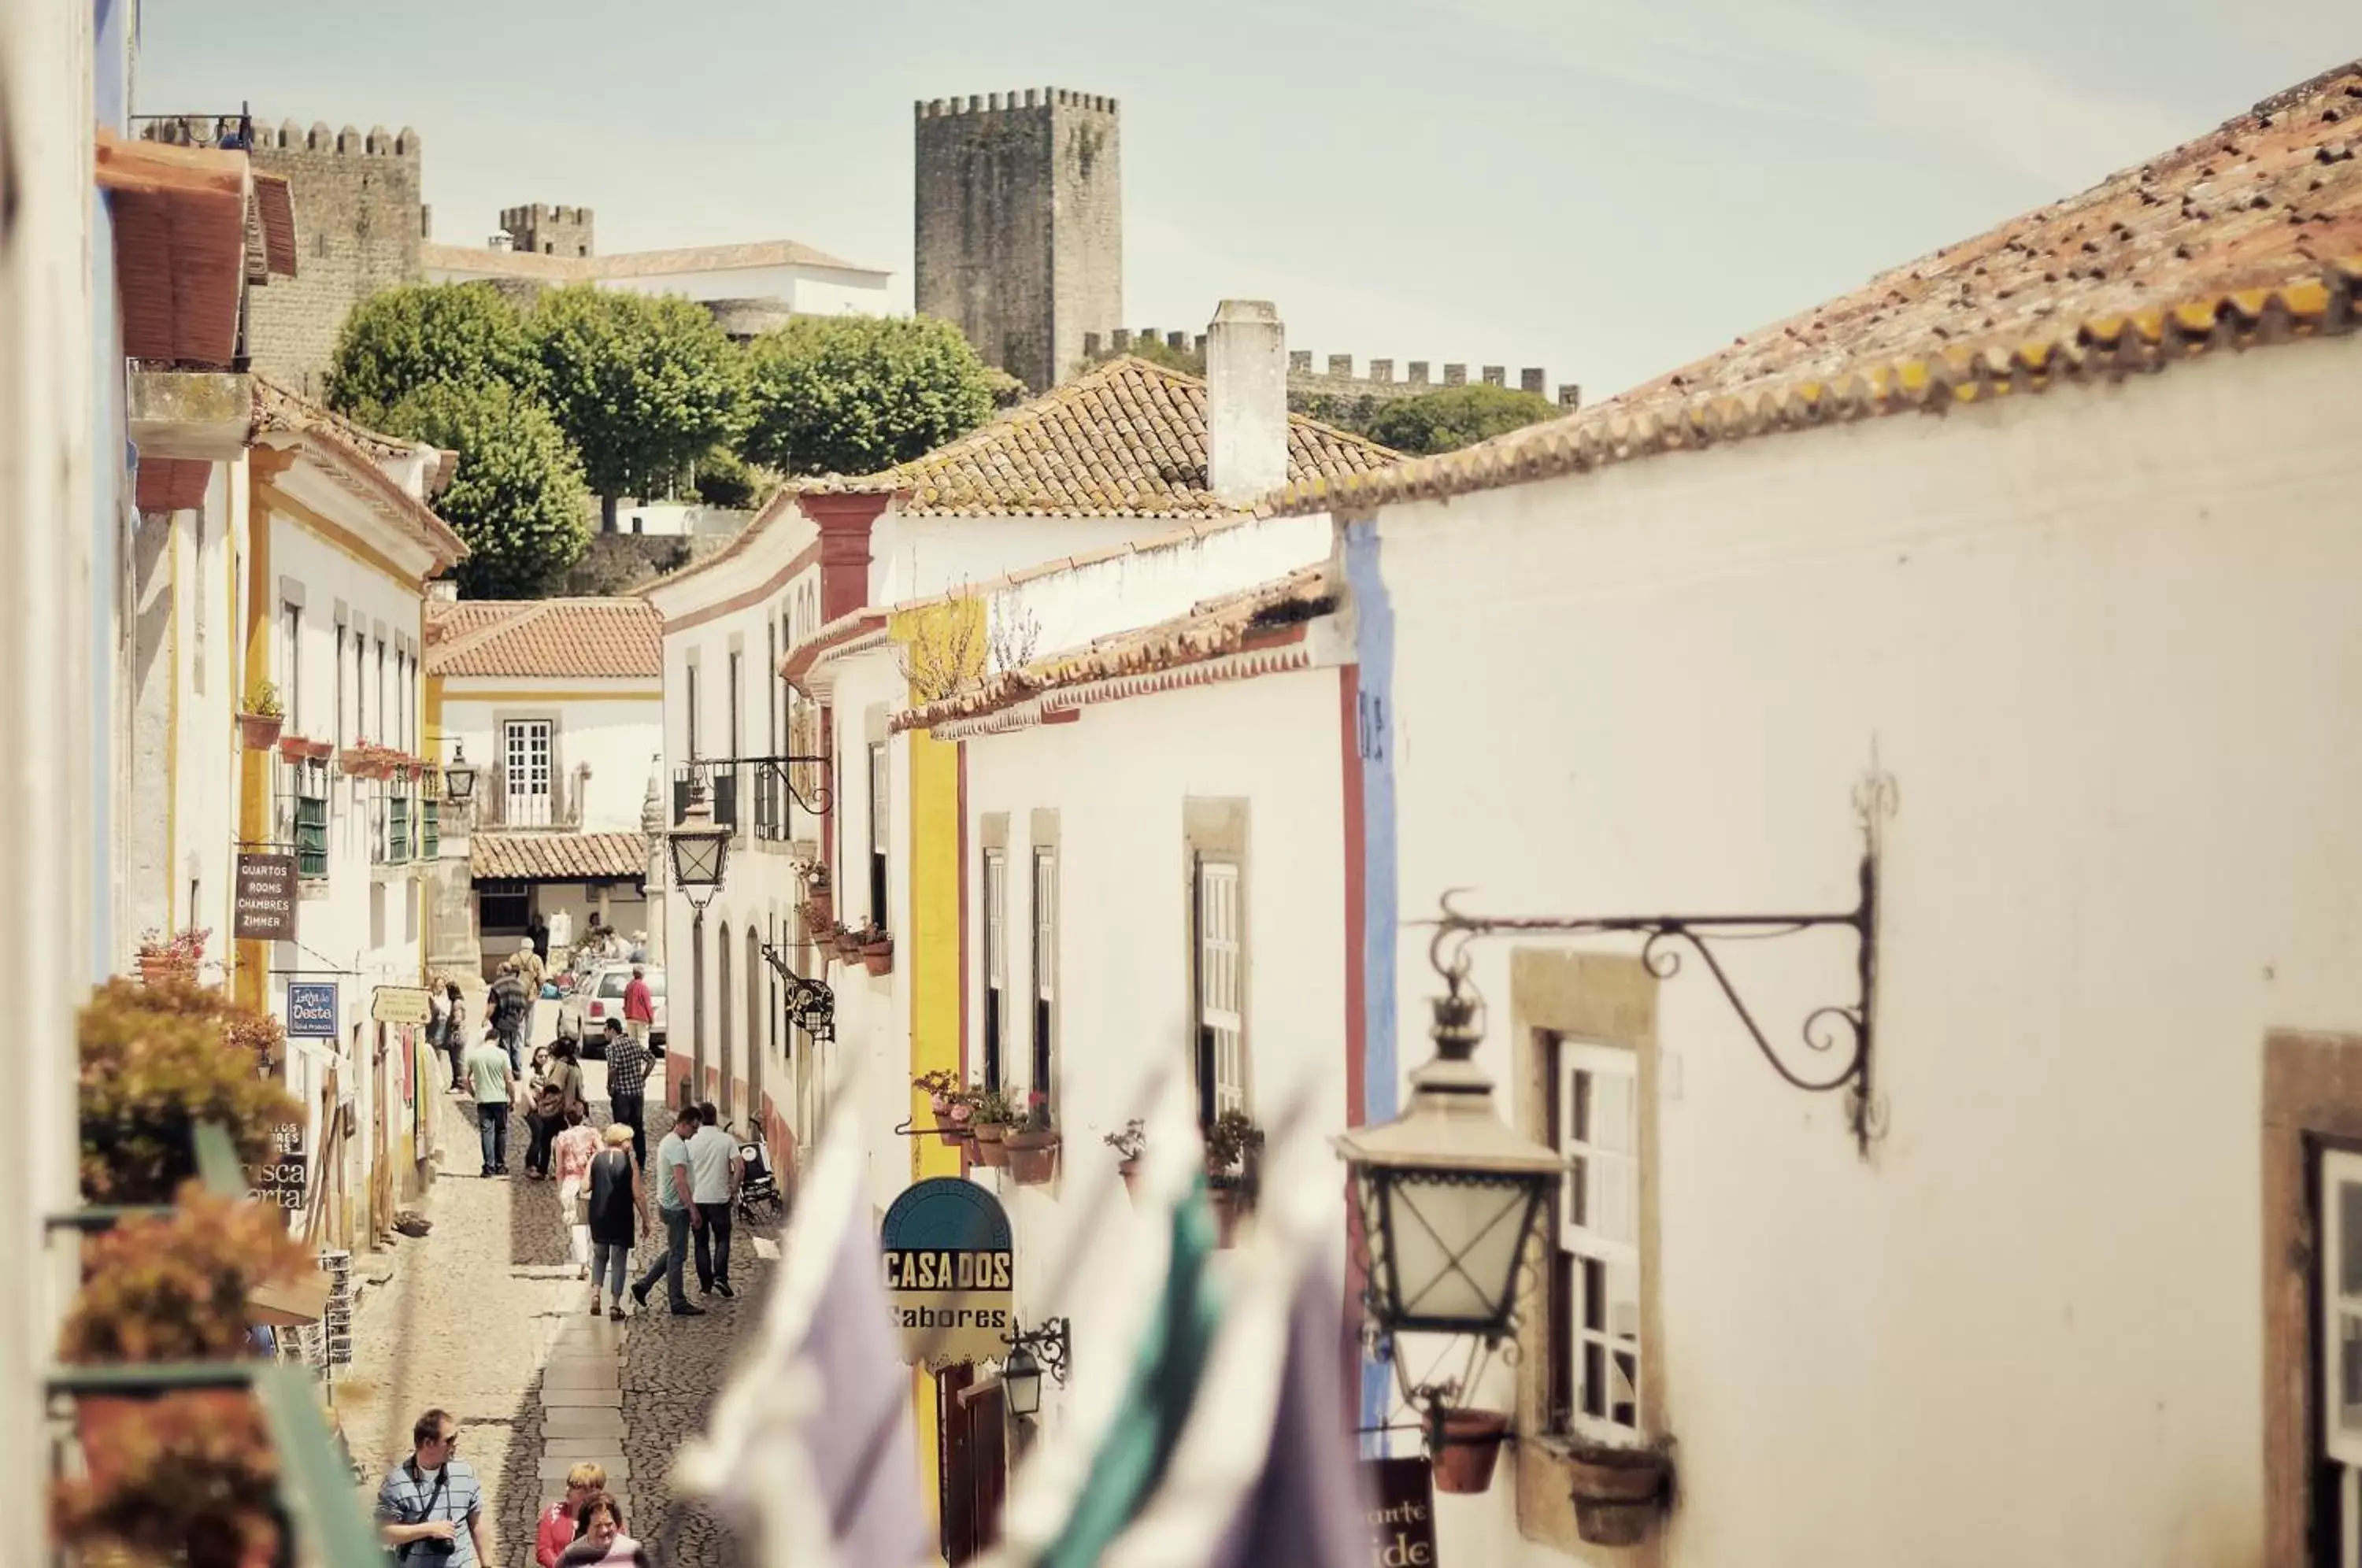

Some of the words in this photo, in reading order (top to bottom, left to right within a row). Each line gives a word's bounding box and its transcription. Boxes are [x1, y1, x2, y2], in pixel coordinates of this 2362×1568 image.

[242, 865, 287, 877] QUARTOS
[248, 882, 283, 893] ROOMS
[239, 898, 289, 911] CHAMBRES
[242, 915, 280, 926] ZIMMER
[245, 1184, 302, 1208] orta
[887, 1305, 1006, 1328] Sabores
